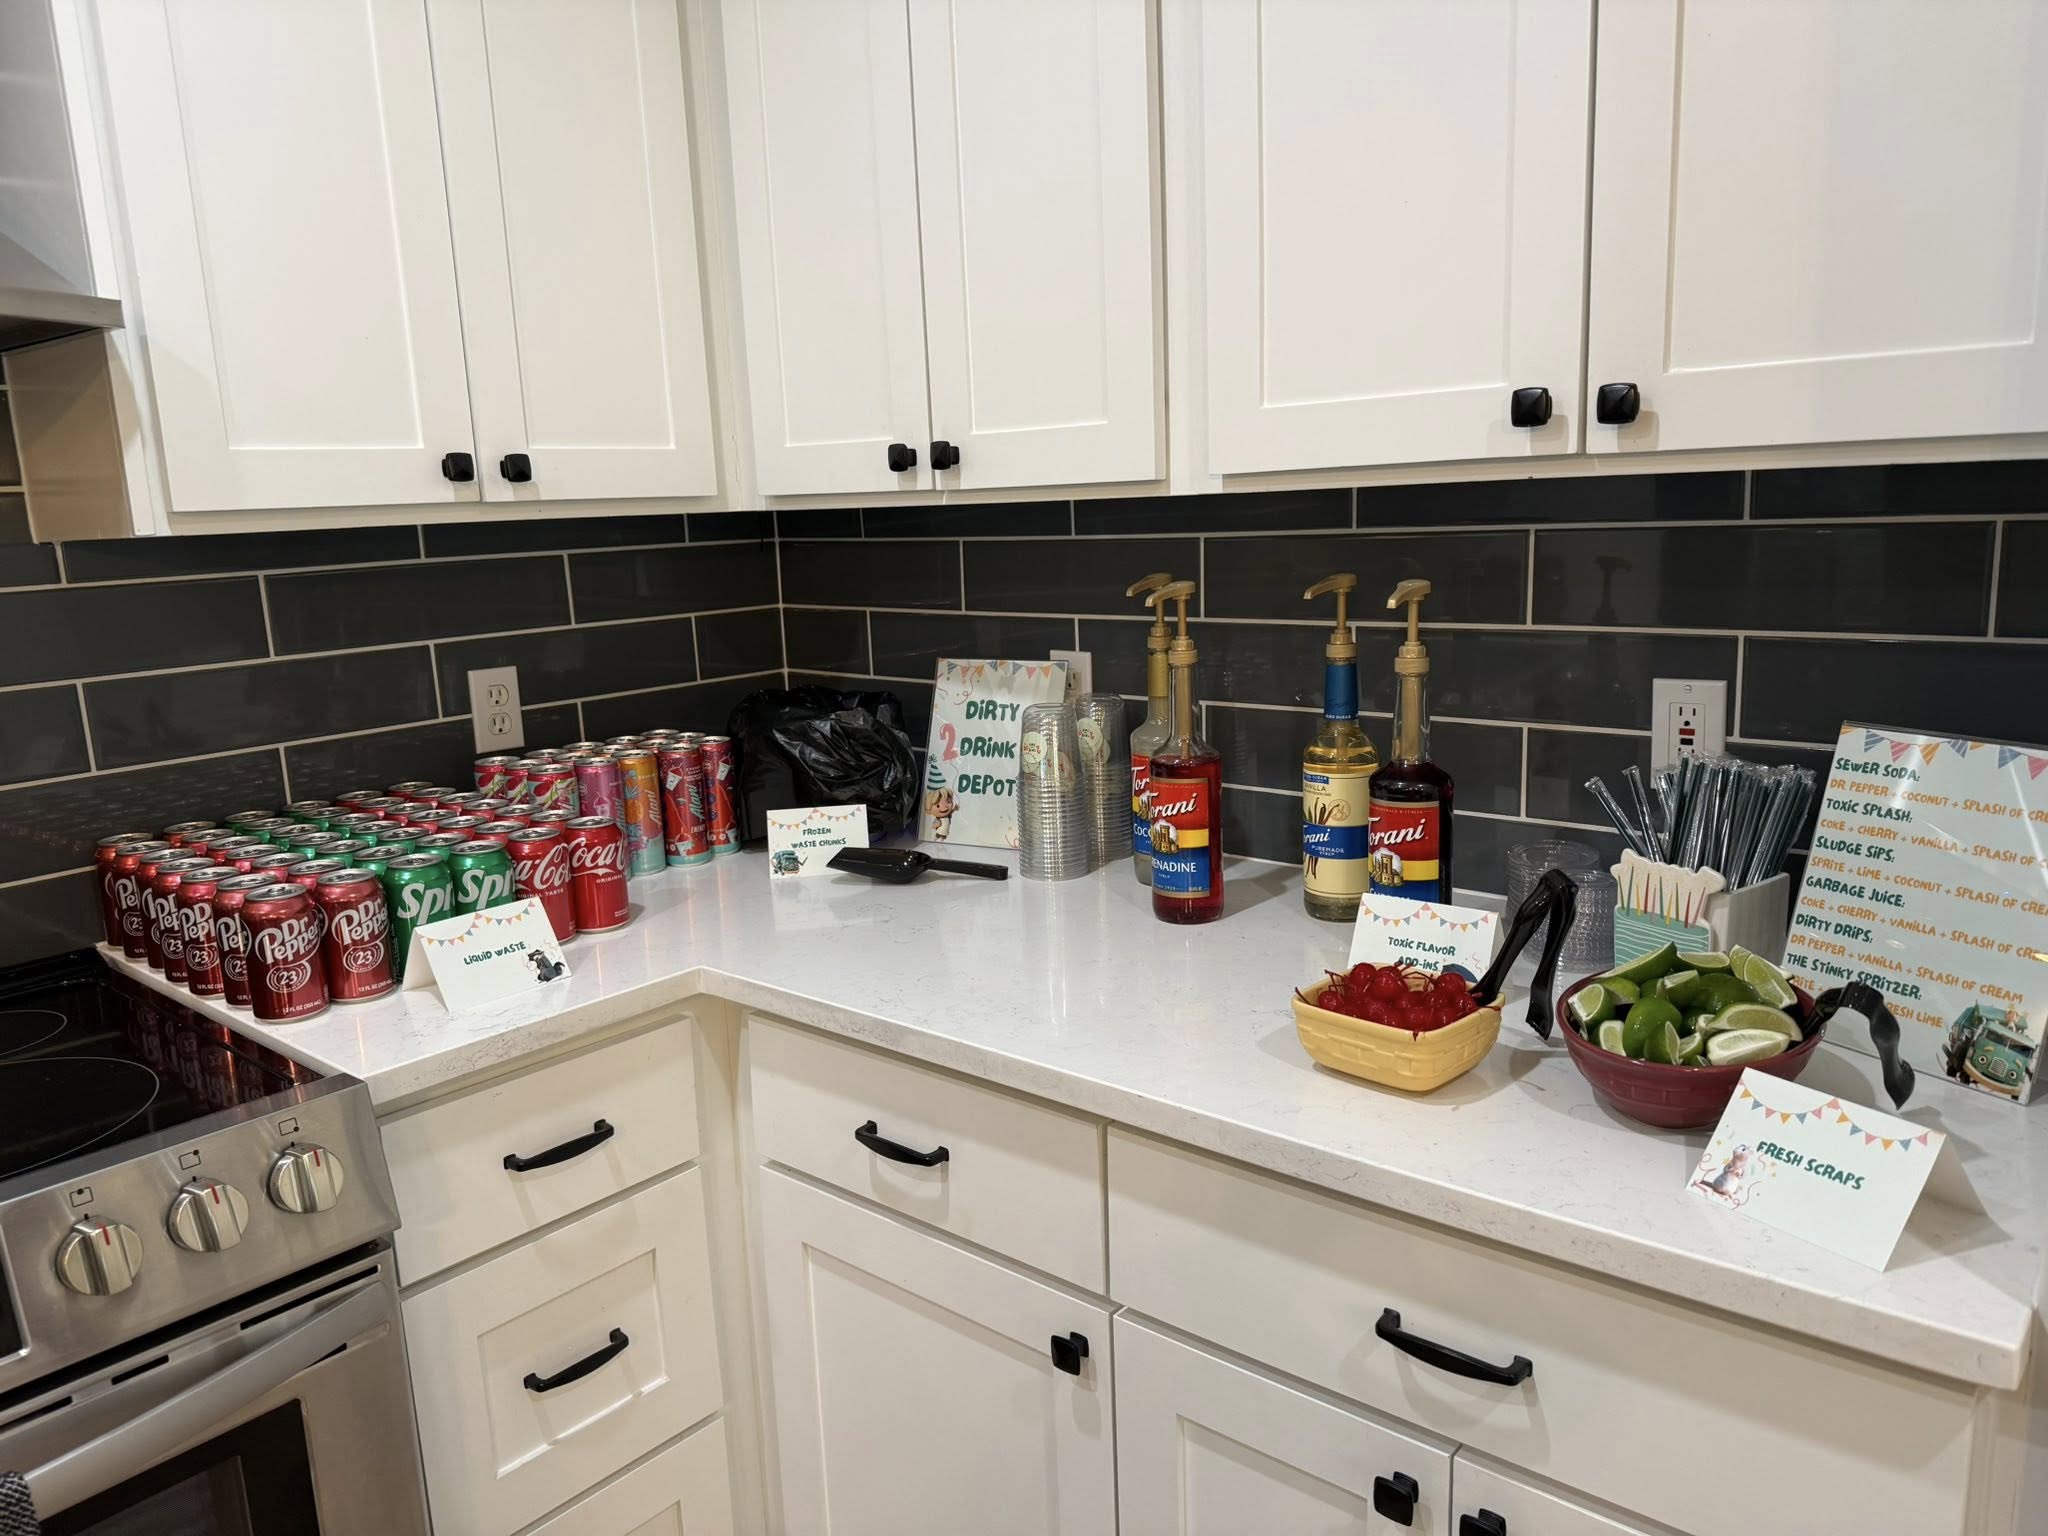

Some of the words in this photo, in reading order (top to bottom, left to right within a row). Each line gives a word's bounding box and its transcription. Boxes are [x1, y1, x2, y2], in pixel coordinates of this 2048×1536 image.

[965, 698, 1020, 722] DIRTY
[959, 736, 1017, 759] DRINK
[1131, 765, 1150, 796] Tor
[1834, 757, 1880, 776] SEWER
[1882, 764, 1921, 782] SODA:
[958, 774, 1017, 797] DEPOT
[1826, 798, 1859, 813] TOXIC
[1861, 802, 1913, 823] SPLASH:
[1849, 781, 1889, 798] PEPPER
[1901, 790, 1950, 807] COCONUT
[1961, 799, 2007, 816] SPLASH
[2009, 808, 2024, 819] OF
[2028, 810, 2048, 823] CRE
[790, 840, 817, 849] WASTE
[819, 837, 847, 847] CHUNKS
[802, 827, 832, 836] FROZEN
[1133, 823, 1152, 838] COC
[1303, 825, 1331, 843] rani
[1368, 816, 1426, 846] Torani
[1820, 818, 1846, 832] COKE
[1857, 825, 1899, 841] CHERRY
[1911, 836, 1959, 853] VANILLA
[1972, 844, 2017, 862] SPLASH
[2020, 855, 2035, 866] OF
[1815, 835, 1863, 856] SLUDGE
[1865, 844, 1895, 863] SIPS:
[1152, 859, 1197, 873] ENADINE
[457, 869, 516, 910] Spr
[1806, 876, 1865, 898] GARBAGE
[1868, 888, 1905, 908] JUICE:
[1810, 856, 1846, 873] SPRITE
[1856, 866, 1881, 881] LIME
[1894, 874, 1943, 893] COCONUT
[1954, 886, 2000, 905] SPLASH
[2002, 897, 2018, 908] OF
[2021, 901, 2048, 917] CRE
[357, 898, 382, 923] Dr
[396, 883, 456, 926] Spr
[281, 916, 309, 942] Dr
[1795, 913, 1832, 932] DIRTY
[1833, 922, 1873, 943] DRIPS:
[1800, 895, 1826, 910] COKE
[1836, 904, 1878, 922] CHERRY
[1890, 918, 1936, 937] VANILLA
[1950, 930, 1995, 950] SPLASH
[1997, 943, 2014, 954] OF
[255, 920, 319, 965] Pepper
[463, 950, 493, 965] LIQUID
[494, 941, 527, 957] WASTE
[1388, 936, 1414, 949] TOXIC
[1415, 941, 1456, 957] FLAVOR
[355, 950, 373, 965] 23
[1790, 934, 1806, 946] DR
[1807, 938, 1846, 957] PEPPER
[1857, 953, 1903, 973] VANILLA
[1915, 966, 1959, 987] SPLASH
[1961, 979, 1977, 991] OF
[1979, 984, 2024, 1004] CREAM
[279, 970, 298, 985] 23
[1787, 952, 1809, 968] THE
[1810, 959, 1854, 981] STINKY
[1856, 970, 1922, 1000] SPRITZER:
[1793, 975, 1815, 991] RITE
[1887, 1002, 1914, 1019] RESH
[1916, 1011, 1944, 1028] LIME
[1756, 1140, 1804, 1167] FRESH
[1804, 1158, 1865, 1190] SCRAPS
